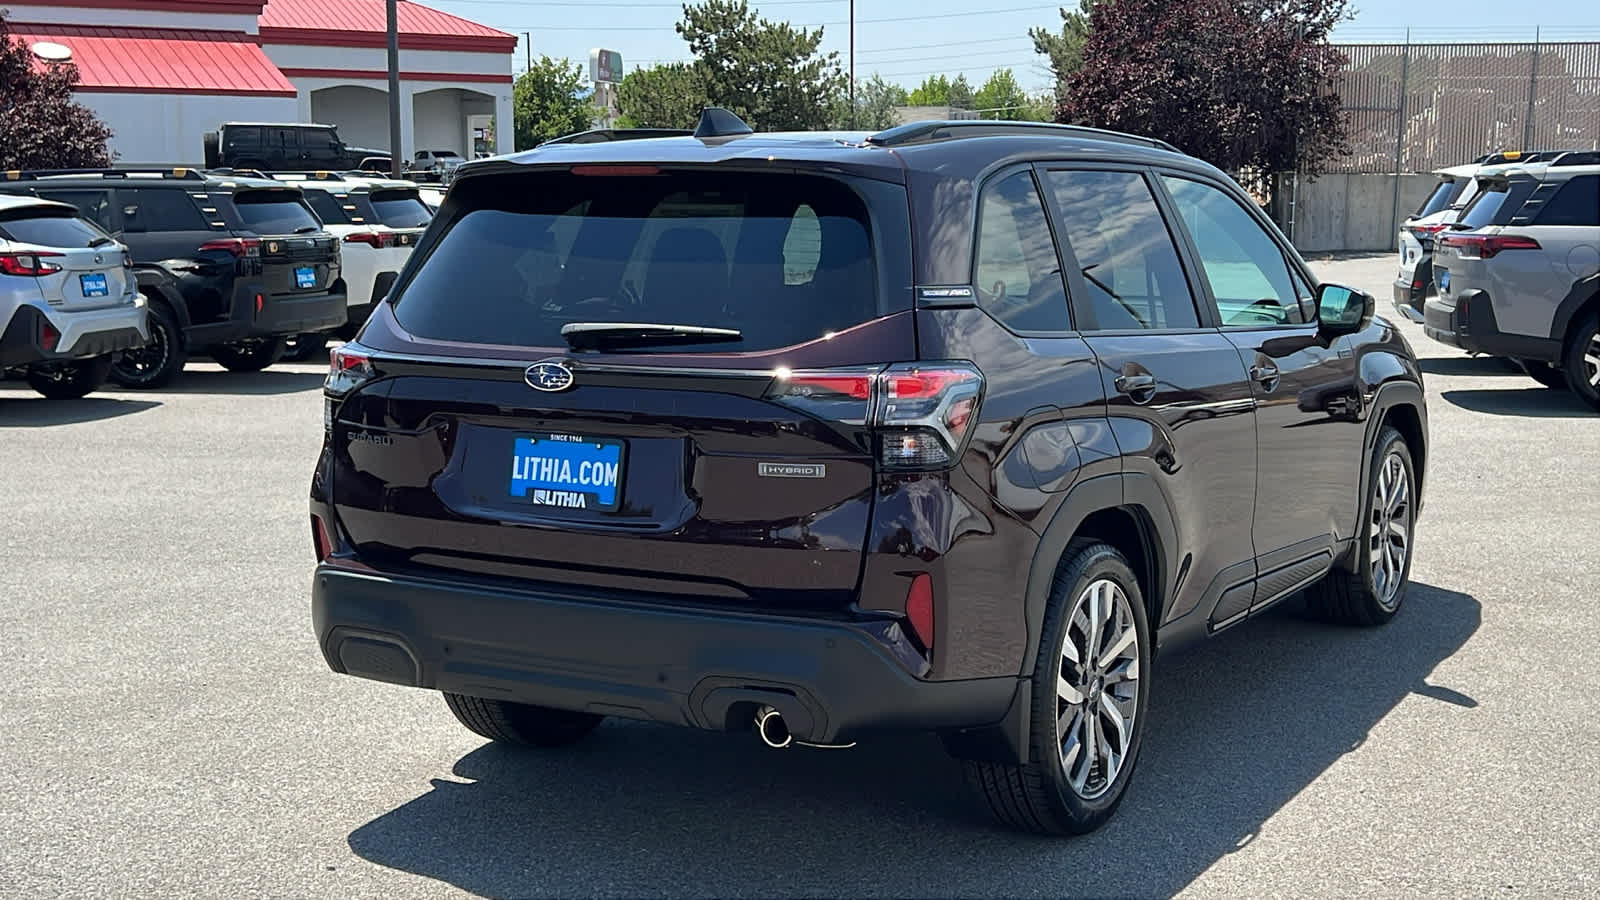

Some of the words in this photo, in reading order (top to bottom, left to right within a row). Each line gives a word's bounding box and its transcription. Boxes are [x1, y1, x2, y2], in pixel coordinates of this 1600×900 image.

[550, 434, 568, 442] SINCE
[512, 455, 619, 488] LITHIA.COM
[768, 466, 814, 474] HYBRID
[546, 489, 586, 508] LITHIA
